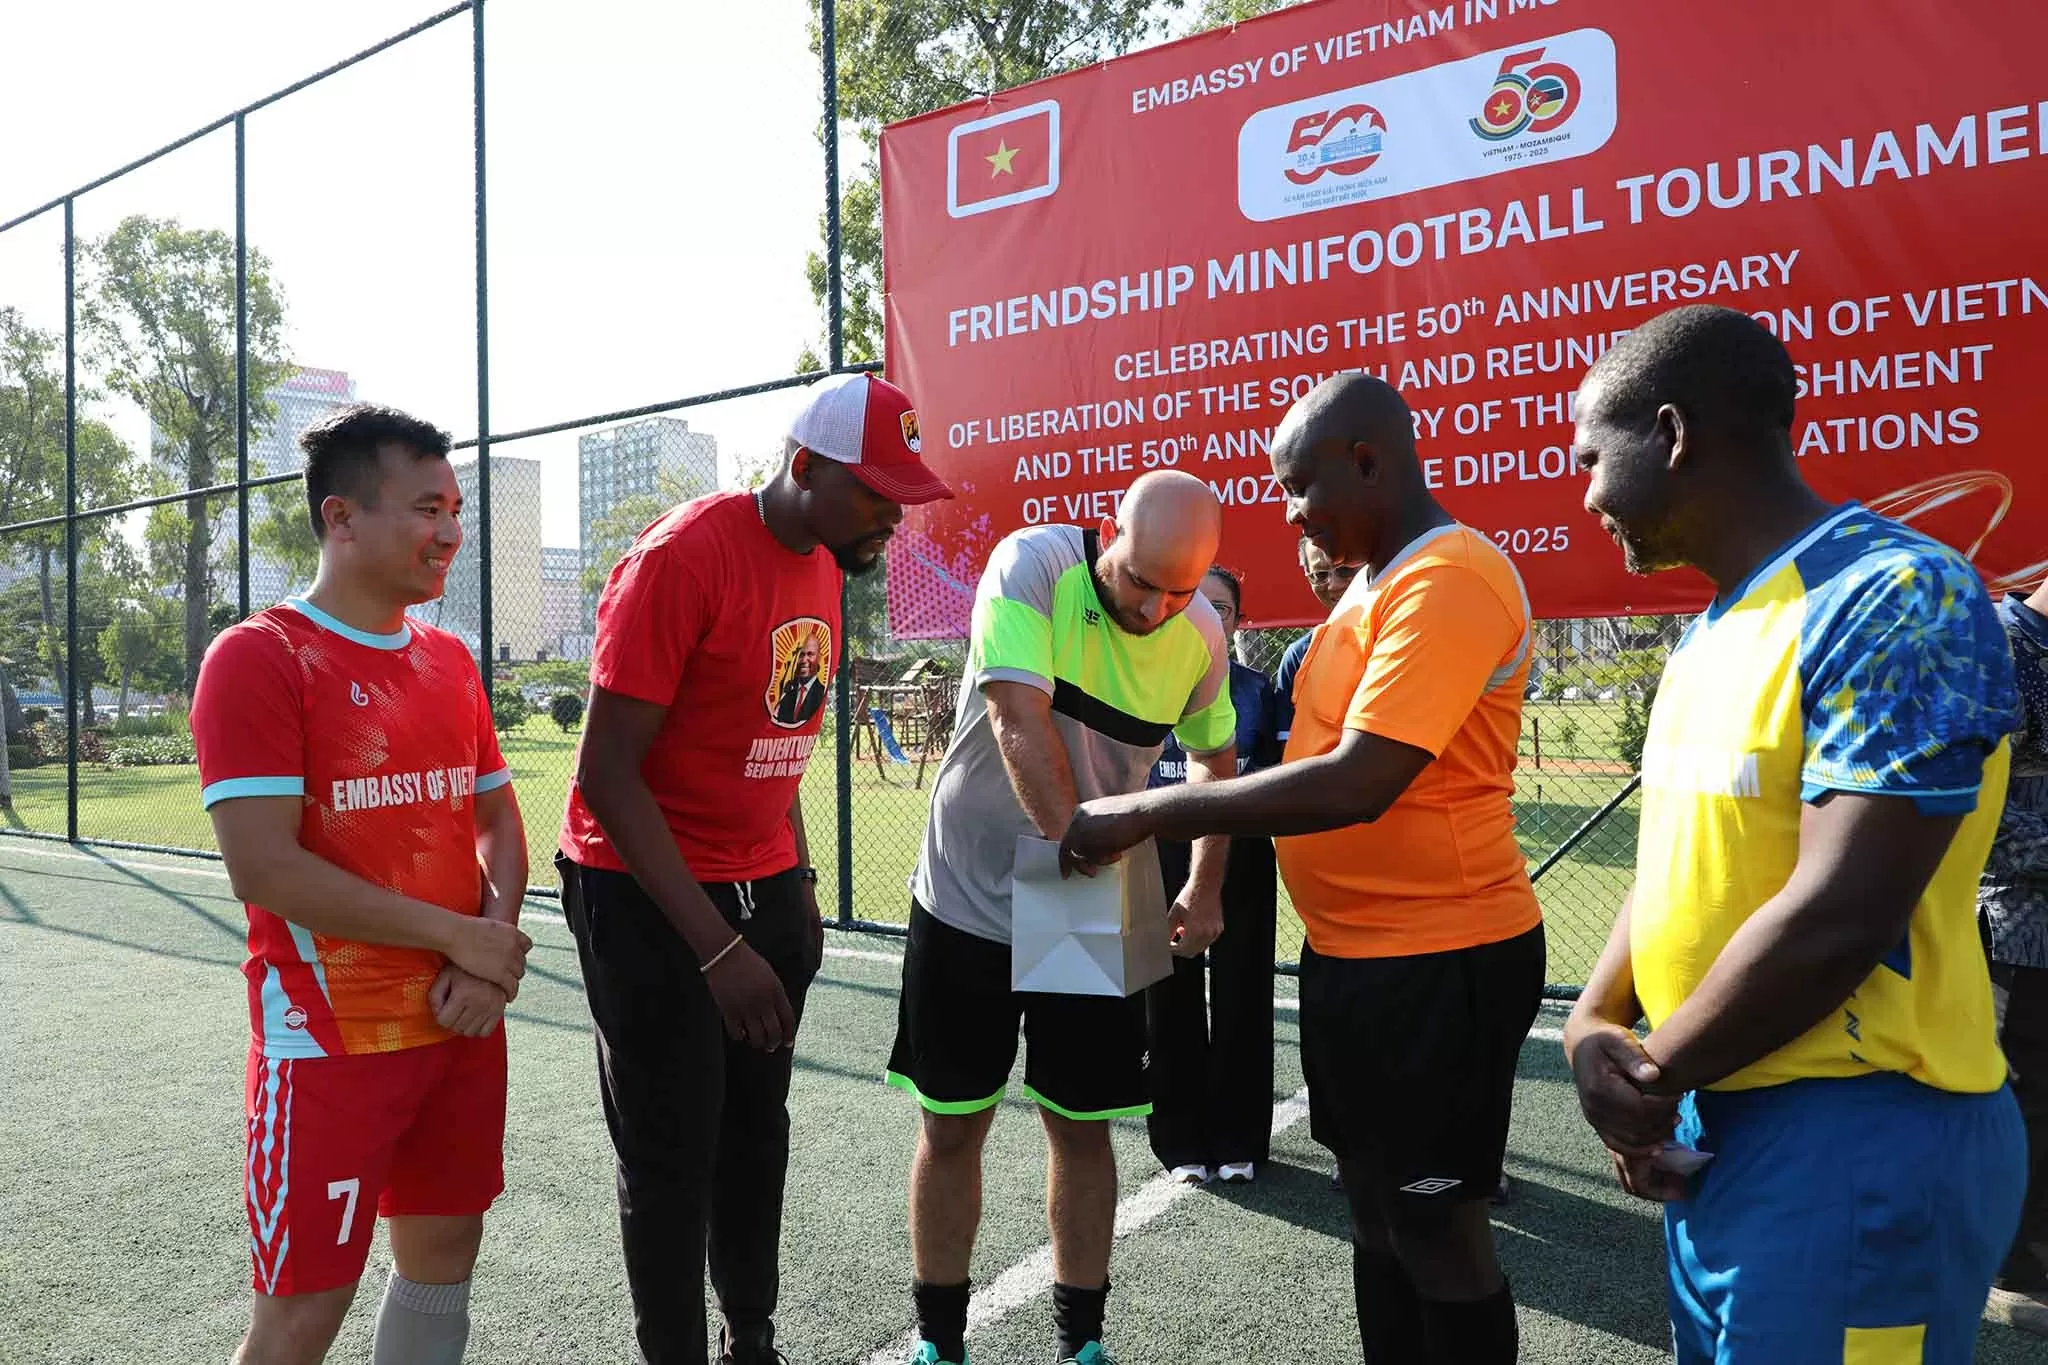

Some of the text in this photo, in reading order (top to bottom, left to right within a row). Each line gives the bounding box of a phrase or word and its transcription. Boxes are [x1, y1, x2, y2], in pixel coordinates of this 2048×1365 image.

[1132, 0, 1498, 114] EMBASSY OF VIETNAM IN
[949, 100, 2048, 348] FRIENDSHIP MINIFOOTBALL TOURNAME
[1114, 249, 1800, 382] CELEBRATING THE 50th ANNIVERSARY
[948, 420, 980, 449] OF
[986, 397, 1144, 444] LIBERATION
[1152, 390, 1192, 421] OF
[1198, 377, 1261, 415] THE
[1397, 353, 1475, 392] AND
[1827, 295, 1890, 336] OF
[1013, 452, 1071, 483] AND
[1077, 443, 1133, 475] THE
[1142, 434, 1198, 468] 50th
[1454, 400, 1502, 435] OF
[1023, 496, 1057, 524] OF
[1063, 489, 1125, 520] VIET
[1794, 407, 1979, 457] ATIONS
[1495, 526, 1569, 554] 2025
[332, 771, 423, 812] EMBASSY
[426, 769, 446, 801] OF
[1159, 760, 1188, 778] EMBAS
[327, 1177, 360, 1245] 7
